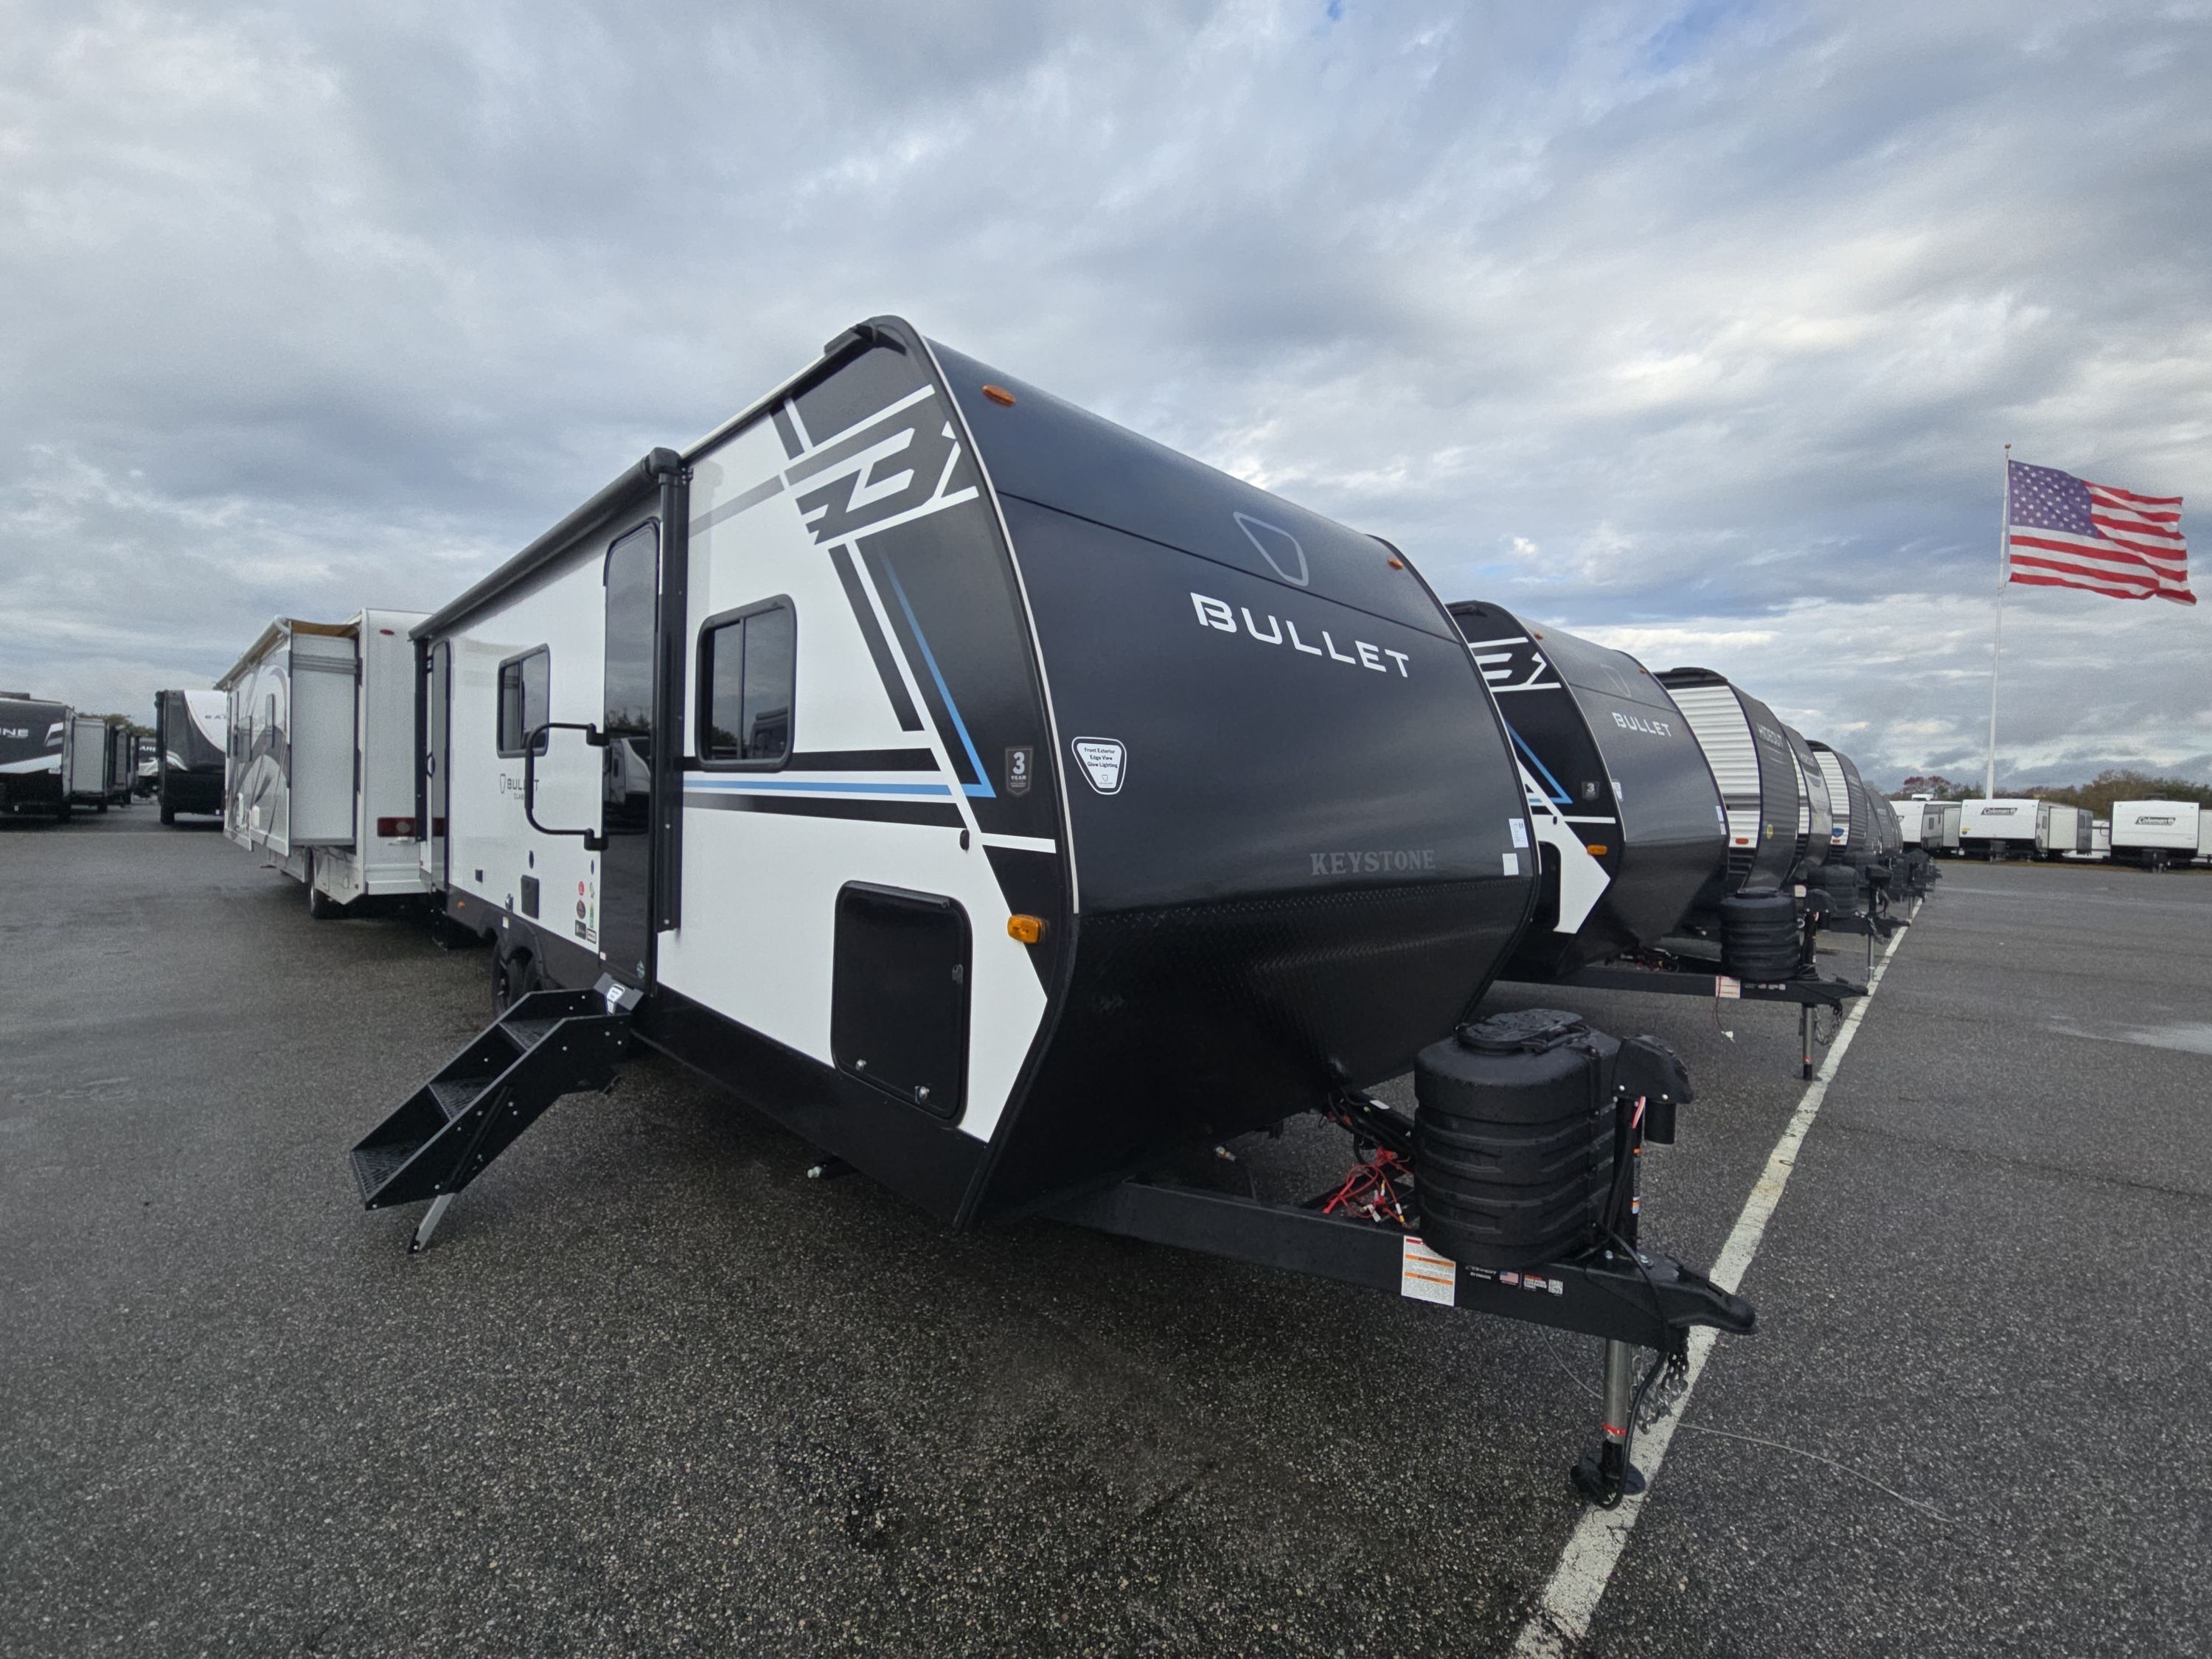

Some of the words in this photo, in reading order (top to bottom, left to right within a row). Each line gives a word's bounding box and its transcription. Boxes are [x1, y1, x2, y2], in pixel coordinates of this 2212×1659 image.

[1190, 592, 1410, 678] BULLET
[0, 728, 29, 737] NE
[1611, 712, 1672, 737] BULLET
[1012, 751, 1026, 774] 3
[507, 778, 540, 791] BULT
[1586, 782, 1596, 792] 3
[1309, 849, 1436, 876] KEYSTONE
